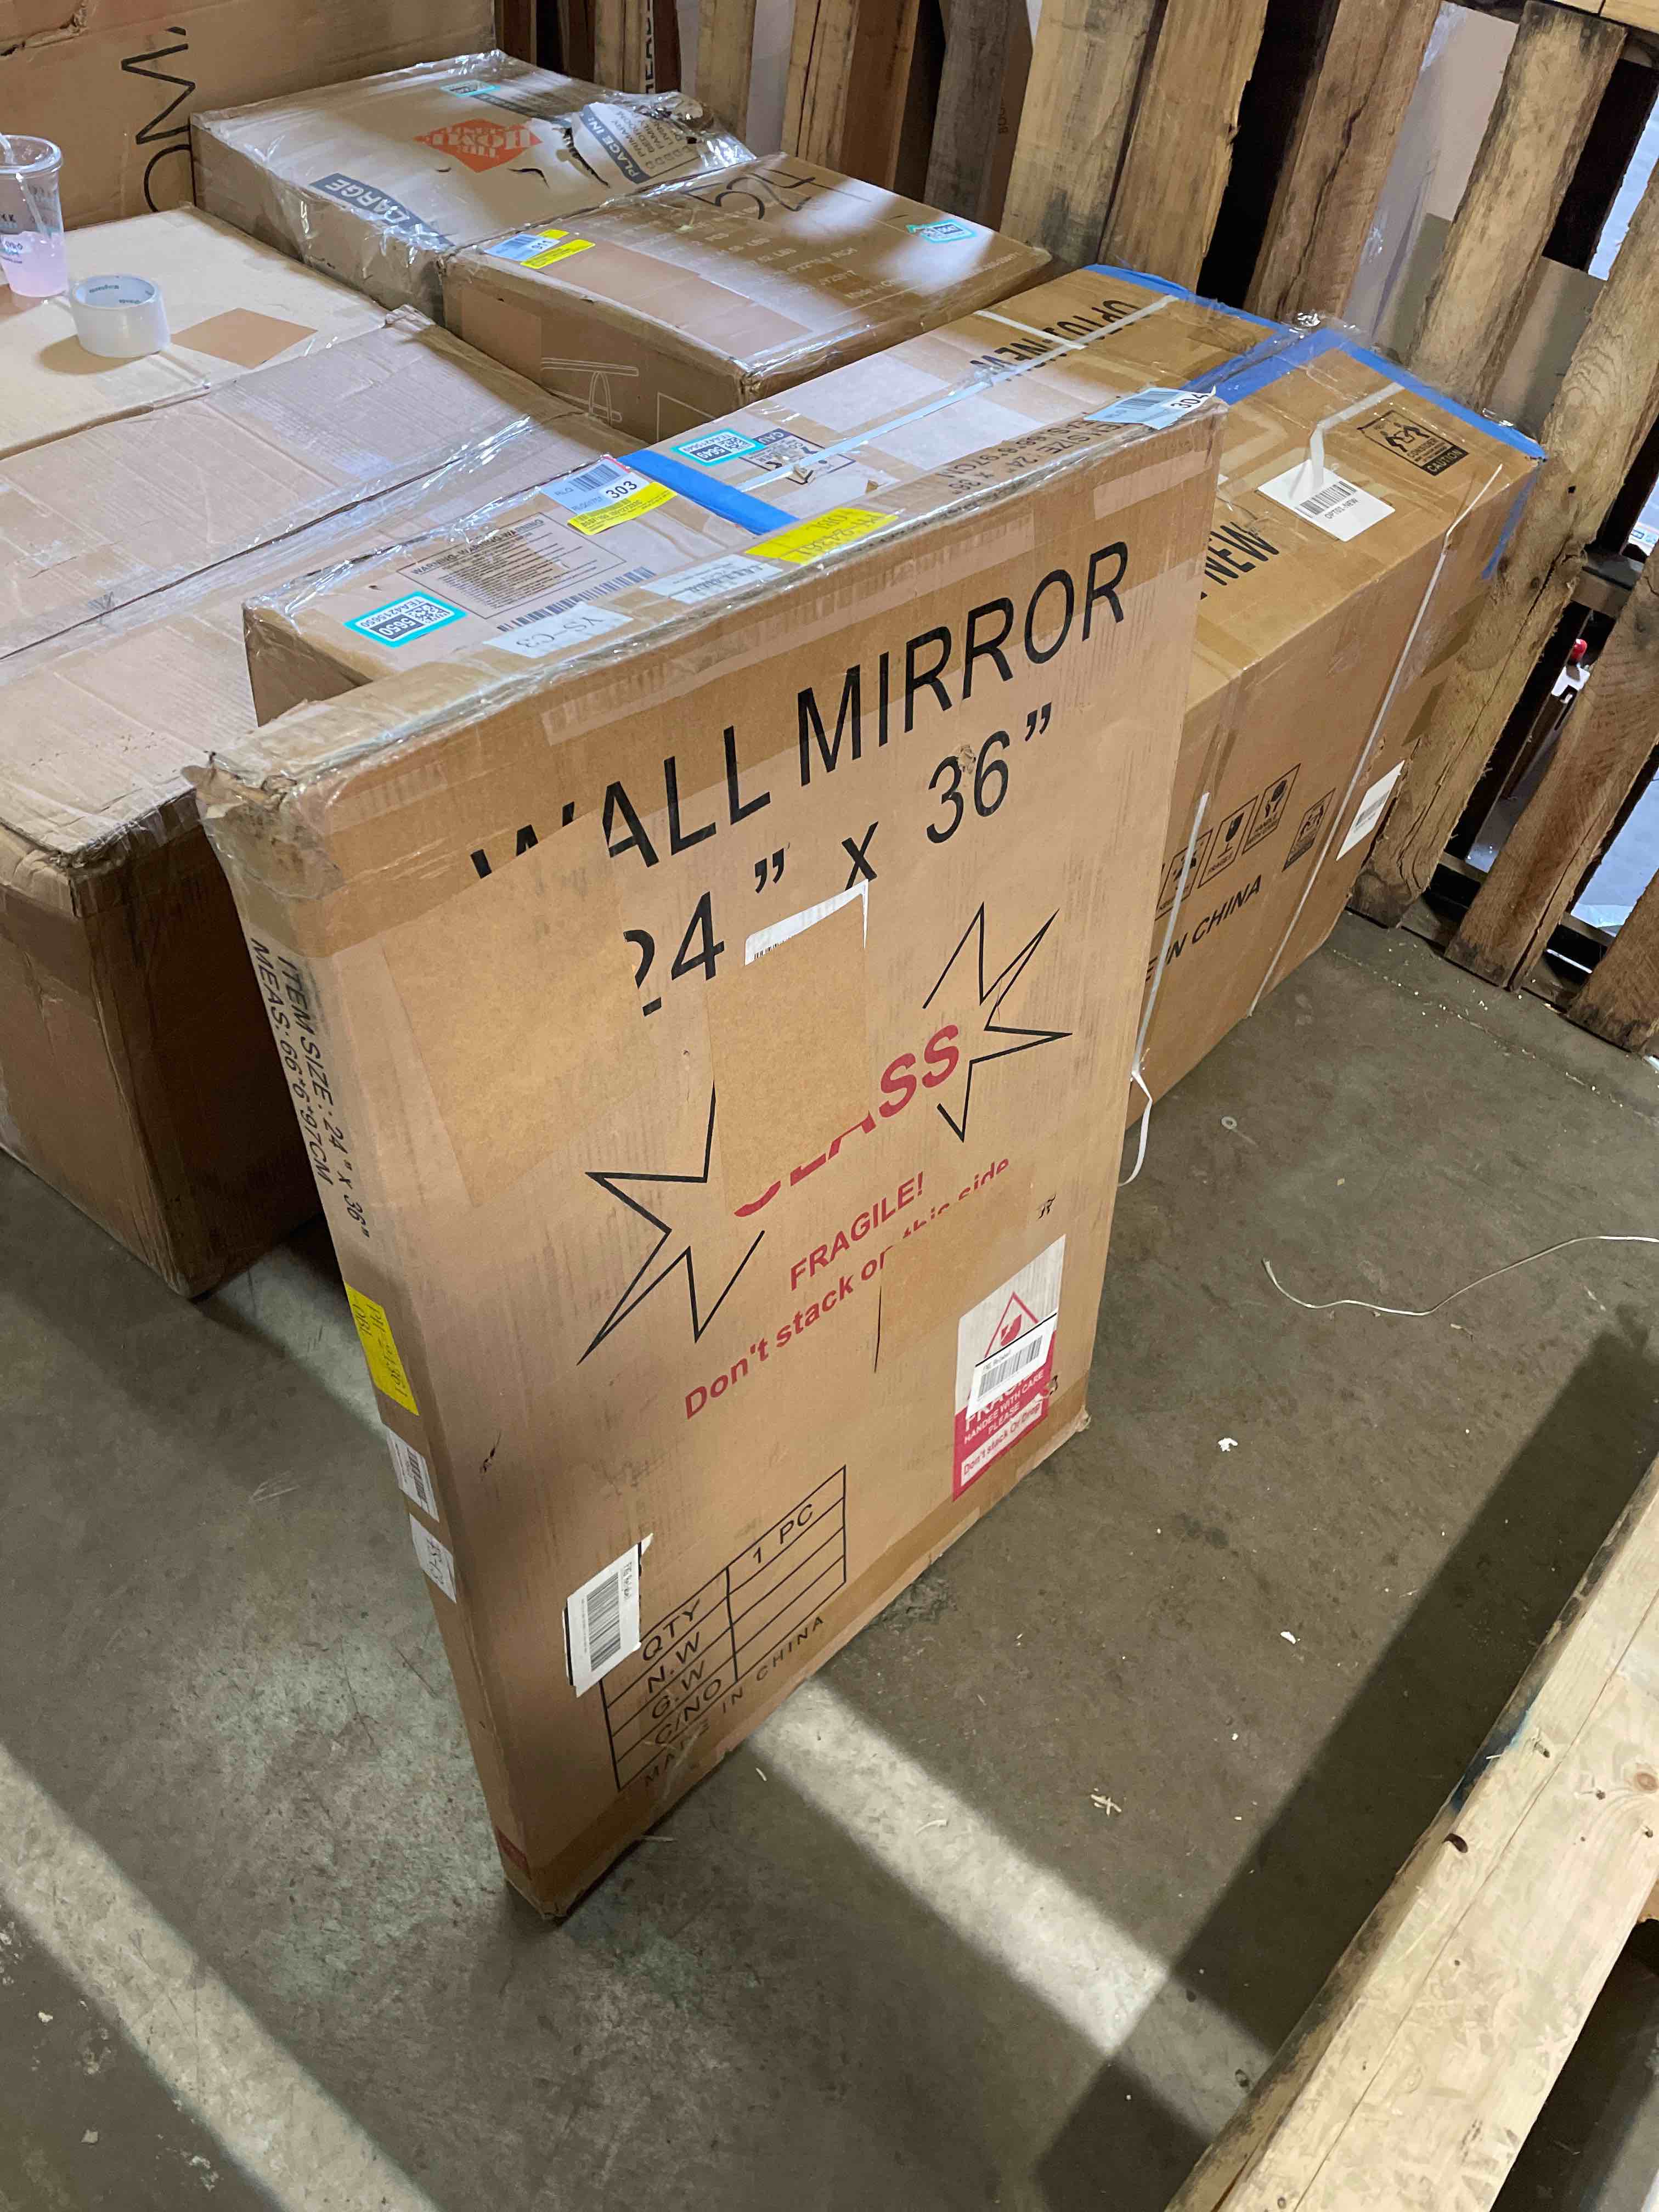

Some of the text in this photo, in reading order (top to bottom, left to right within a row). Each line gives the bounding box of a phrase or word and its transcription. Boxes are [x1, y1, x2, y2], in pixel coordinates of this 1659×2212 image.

[602, 135, 639, 177] PLACE
[696, 445, 725, 462] 5649
[1426, 449, 1464, 473] CAUTION
[605, 480, 638, 500] 303
[360, 595, 424, 629] TEA4215650
[380, 614, 413, 637] 5650
[471, 726, 770, 879] ALL
[798, 541, 1127, 786] MIRROR
[1166, 874, 1262, 965] IN CHINA
[278, 956, 315, 1035] ITEM
[791, 1172, 924, 1290] FRAGILE!
[685, 1339, 769, 1419] Don't
[776, 1273, 854, 1348] stack
[1000, 1393, 1022, 1414] WITH
[1022, 1370, 1043, 1395] CARE
[989, 1403, 1020, 1435] PLEASE
[642, 1504, 812, 1661] QTY 1 PC
[722, 1686, 742, 1714] IN
[757, 1616, 825, 1681] CHINA
